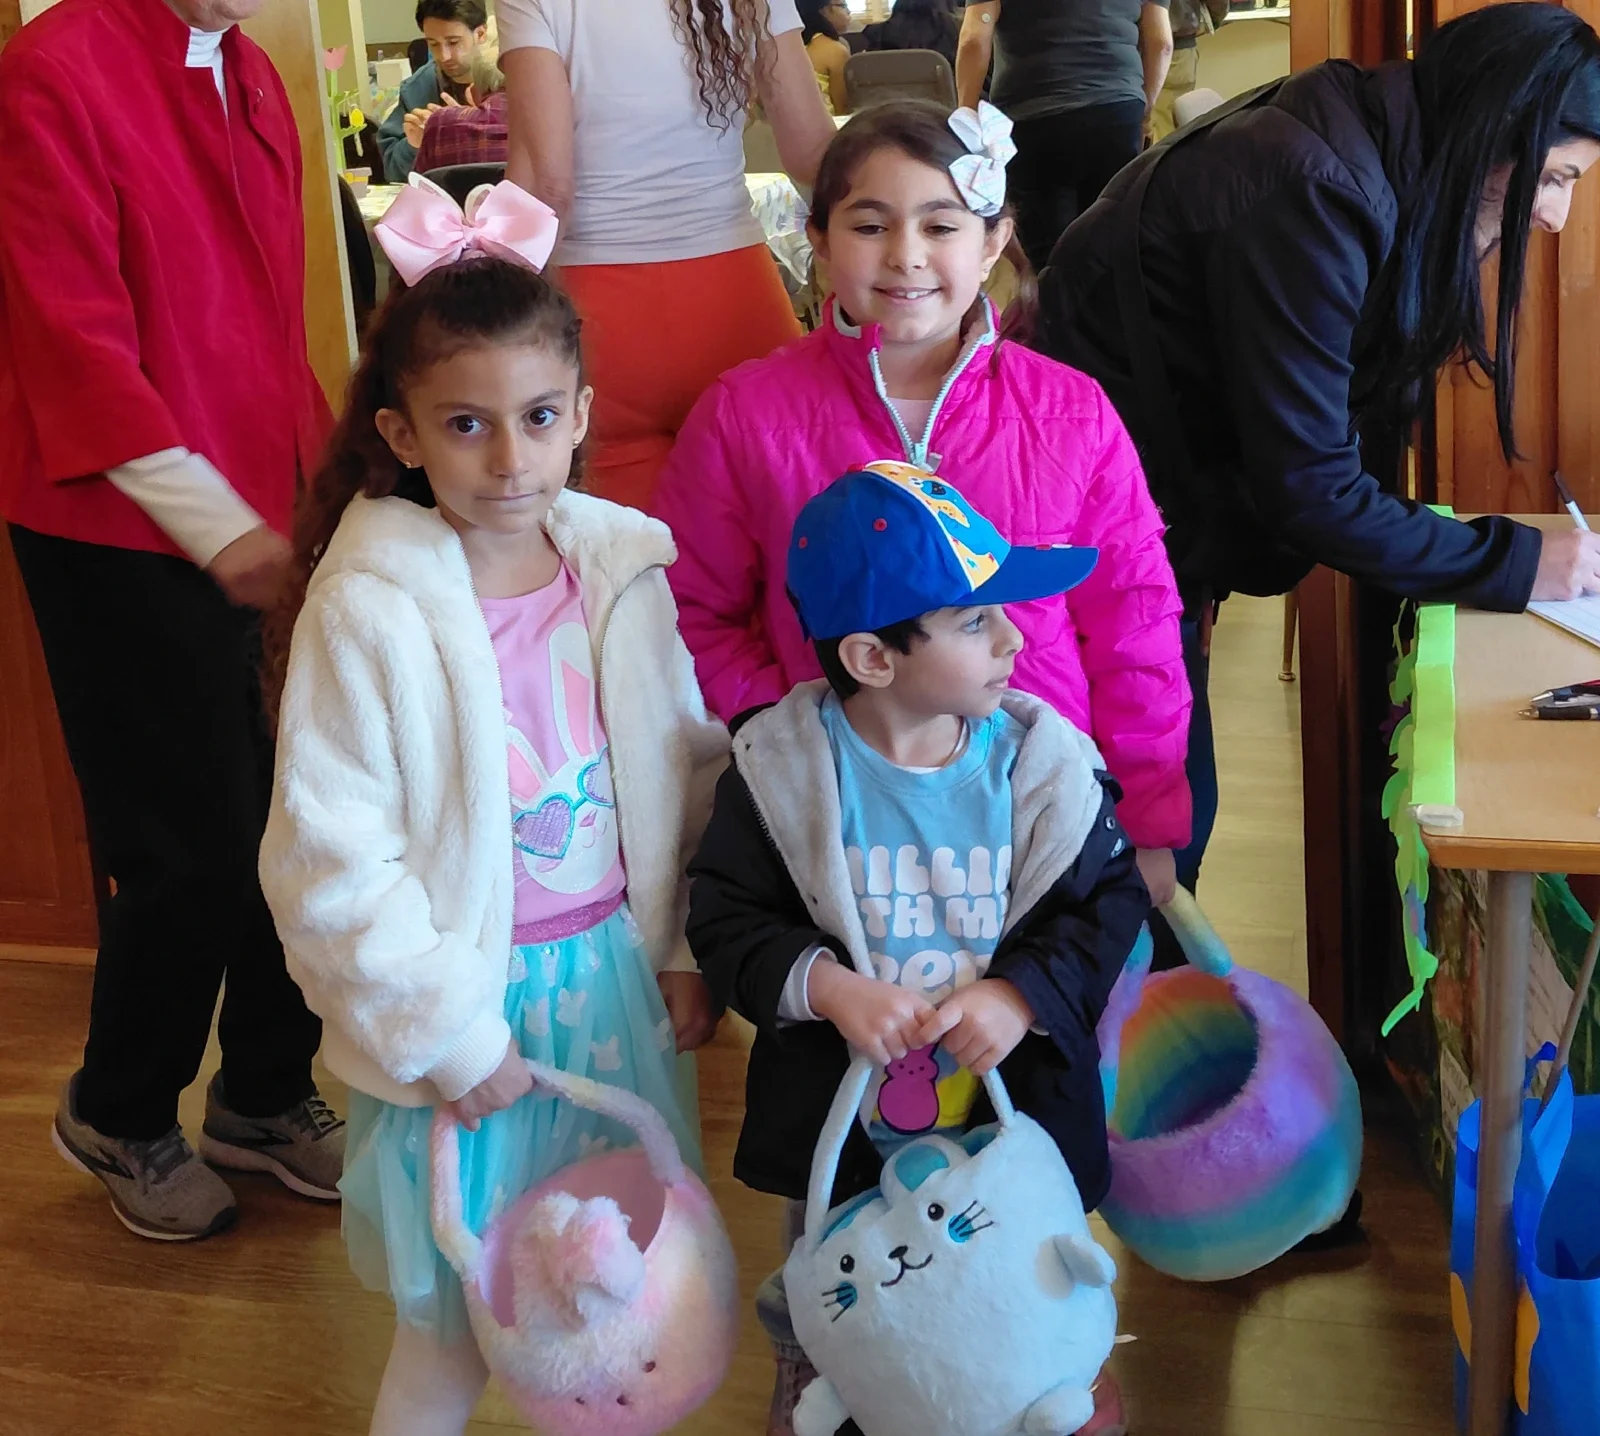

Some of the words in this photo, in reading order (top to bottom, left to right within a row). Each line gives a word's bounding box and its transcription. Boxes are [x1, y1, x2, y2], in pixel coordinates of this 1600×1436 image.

[846, 844, 1012, 897] ILLI
[860, 894, 936, 939] TH
[945, 895, 1008, 940] M
